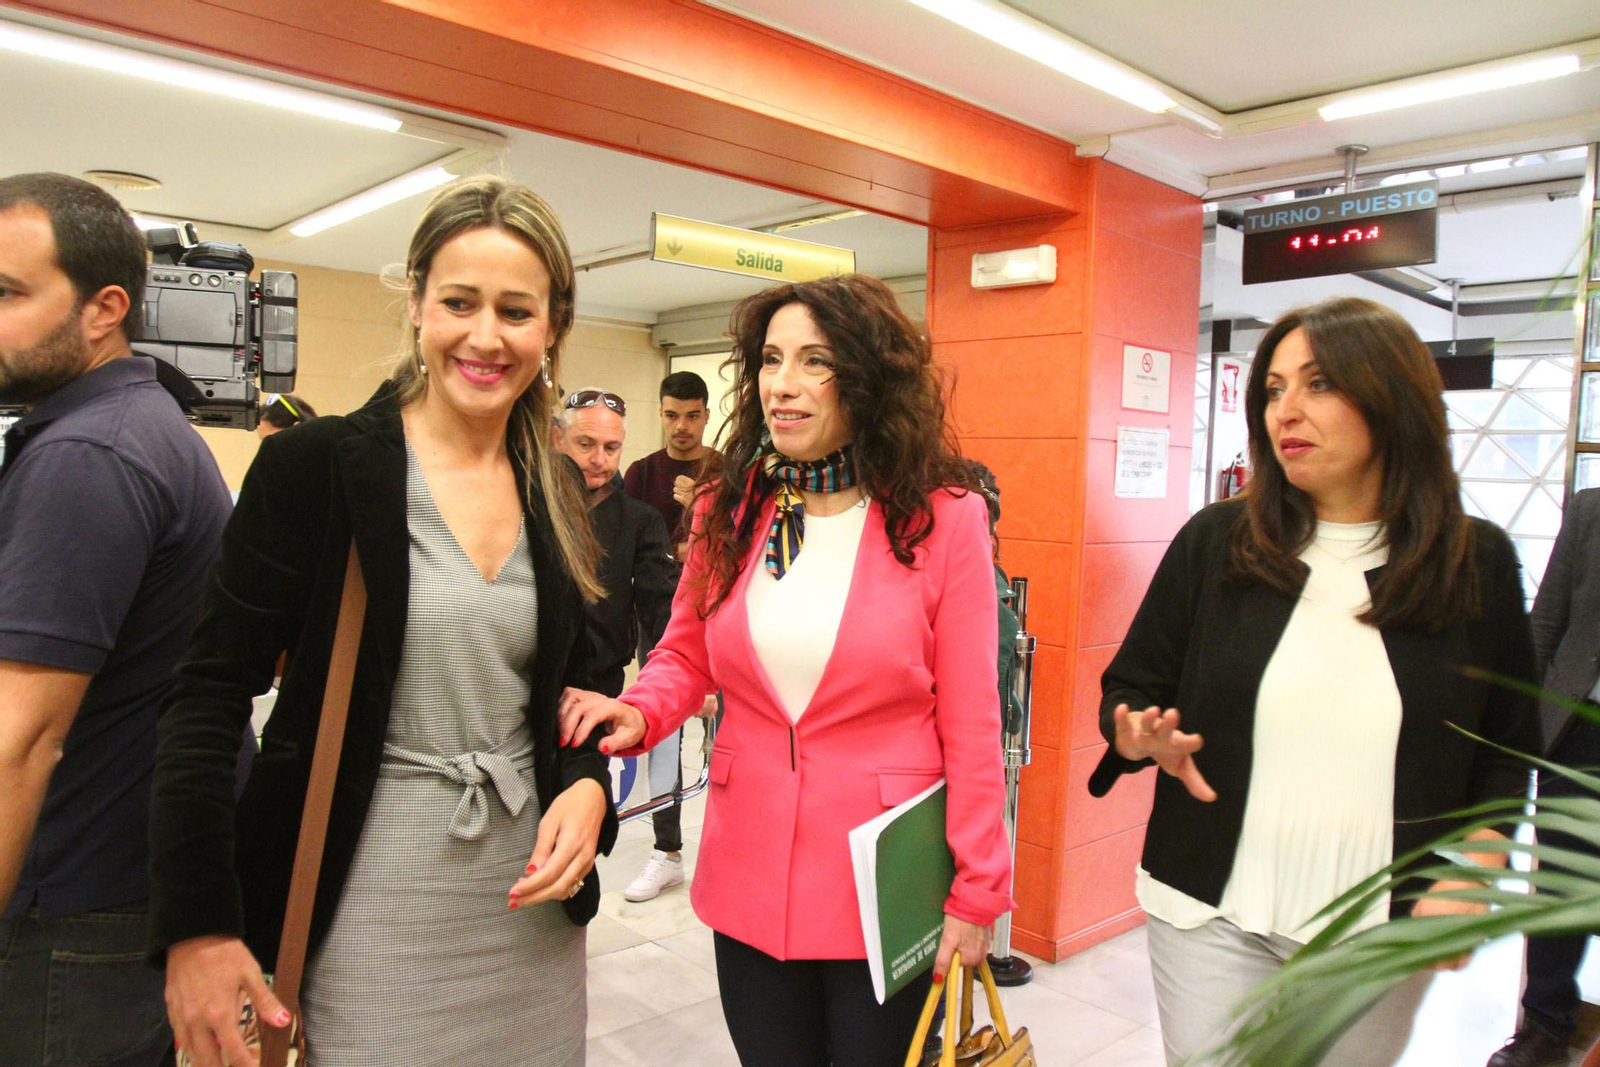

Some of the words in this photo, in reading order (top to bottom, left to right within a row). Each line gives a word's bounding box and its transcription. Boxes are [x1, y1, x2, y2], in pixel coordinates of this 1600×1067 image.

[1248, 206, 1321, 230] TURNO
[1340, 188, 1435, 217] PUESTO
[736, 248, 783, 273] Salida
[1447, 341, 1457, 356] 4
